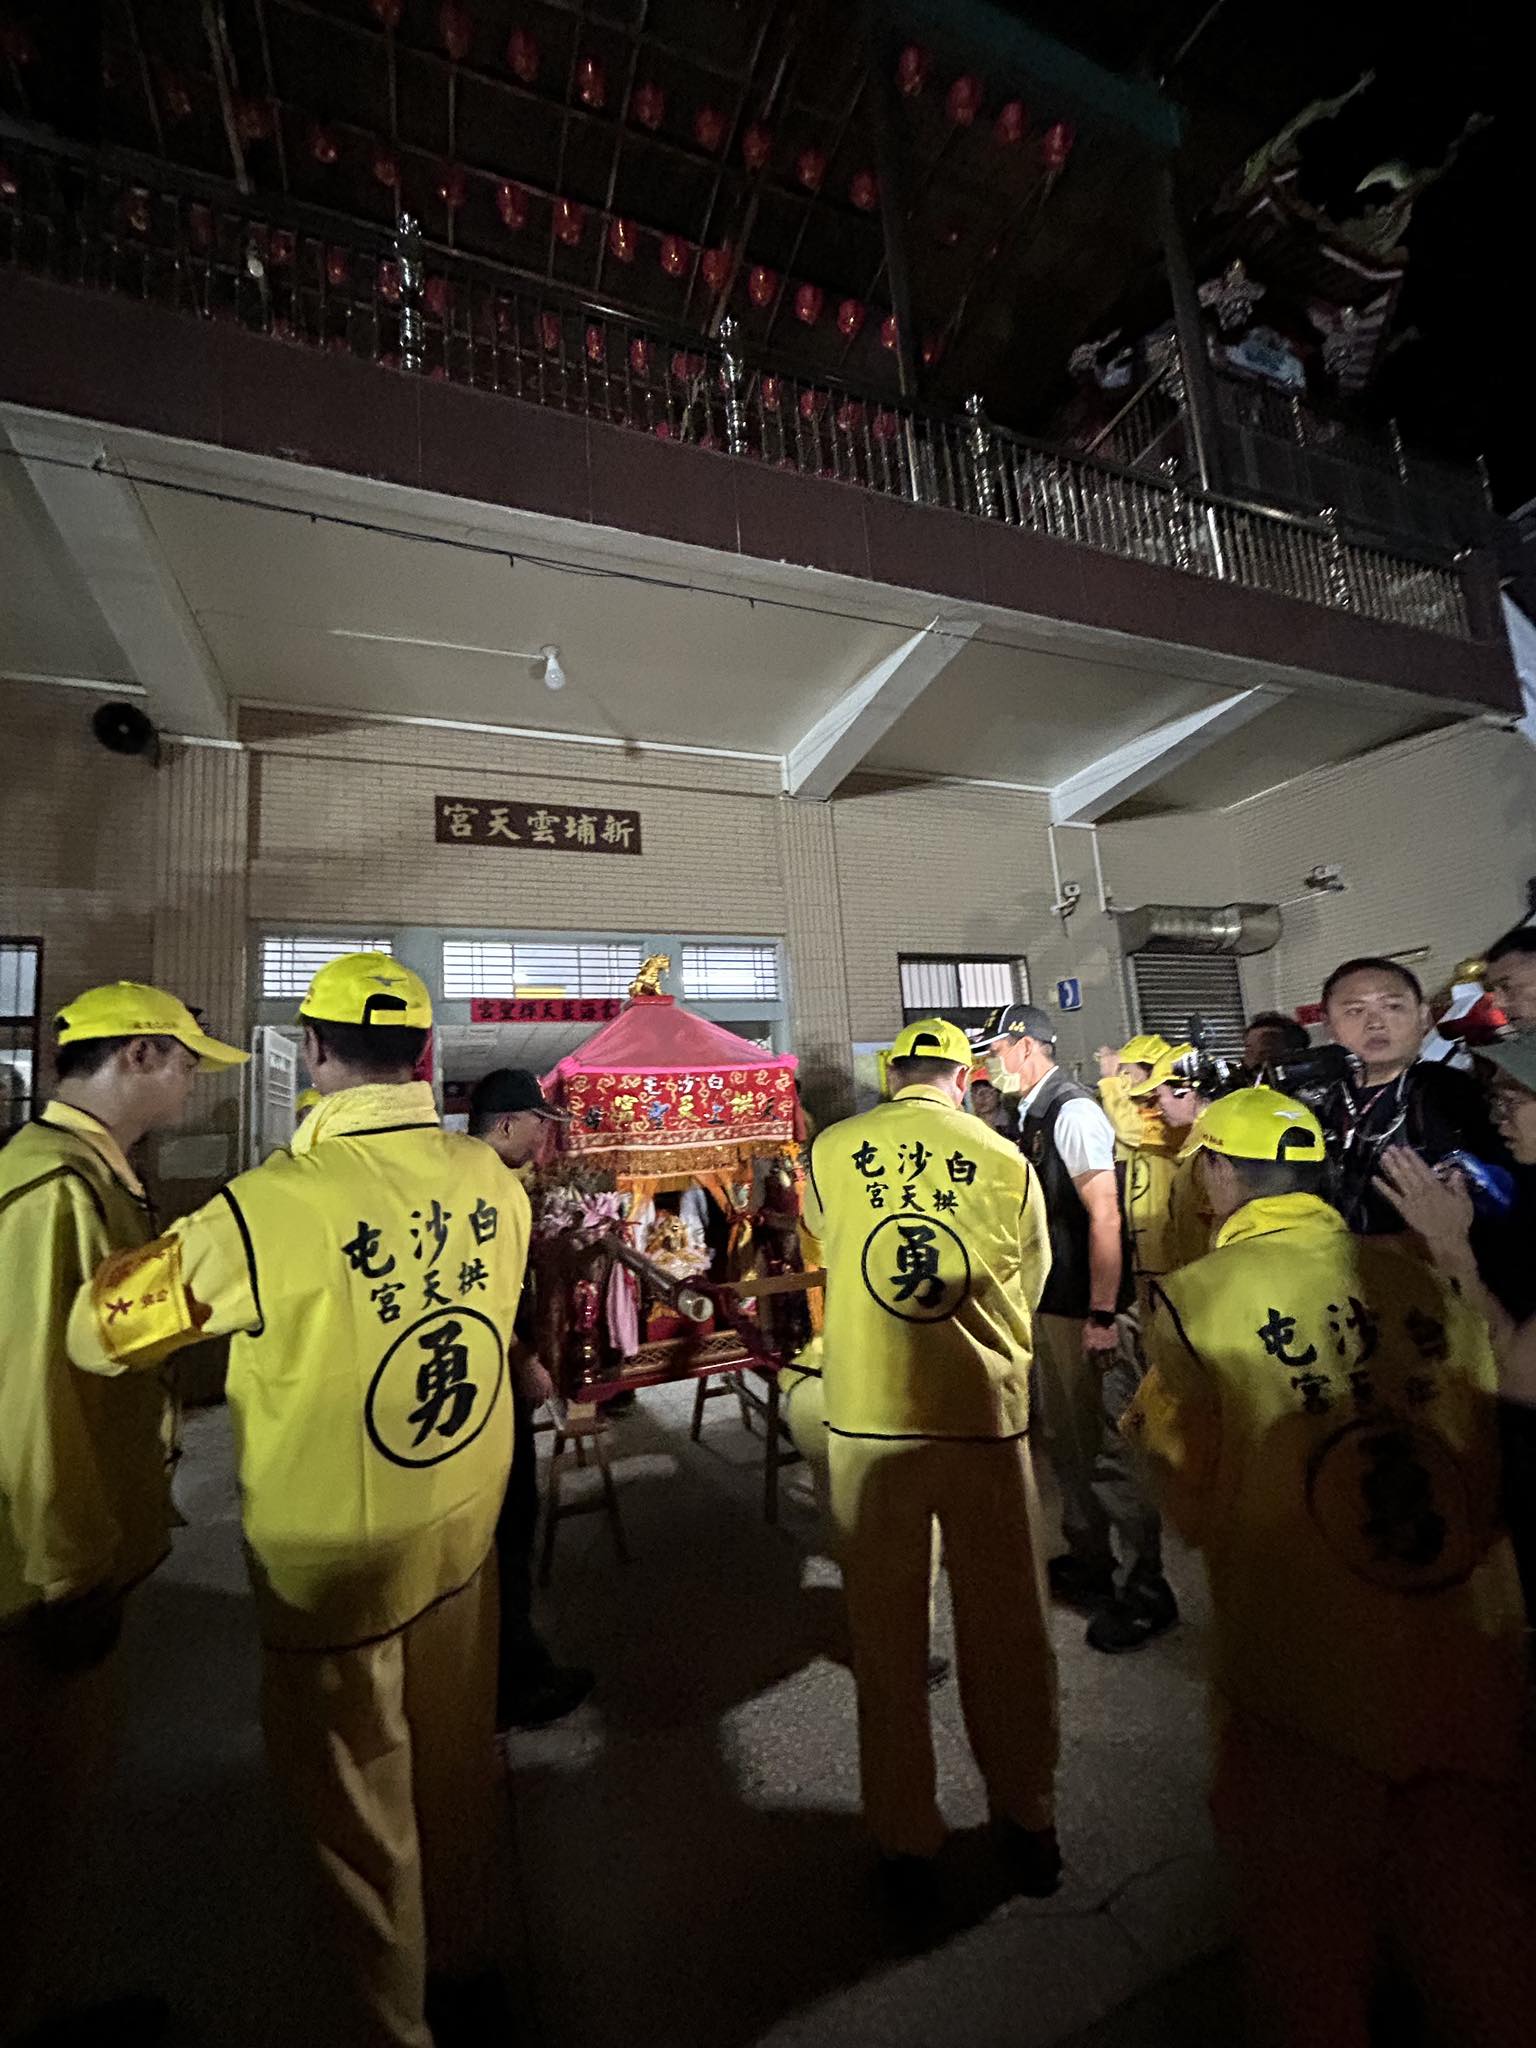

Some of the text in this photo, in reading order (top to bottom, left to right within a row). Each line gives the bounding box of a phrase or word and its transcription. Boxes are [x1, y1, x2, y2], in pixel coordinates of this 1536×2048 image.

[442, 804, 635, 848] 新埔雲天宮
[851, 1140, 978, 1186] 白沙屯
[866, 1182, 960, 1216] 拱天宮
[341, 1197, 499, 1279] 白沙屯
[889, 1224, 946, 1309] 勇
[370, 1257, 490, 1325] 拱天宮
[406, 1319, 479, 1448] 勇
